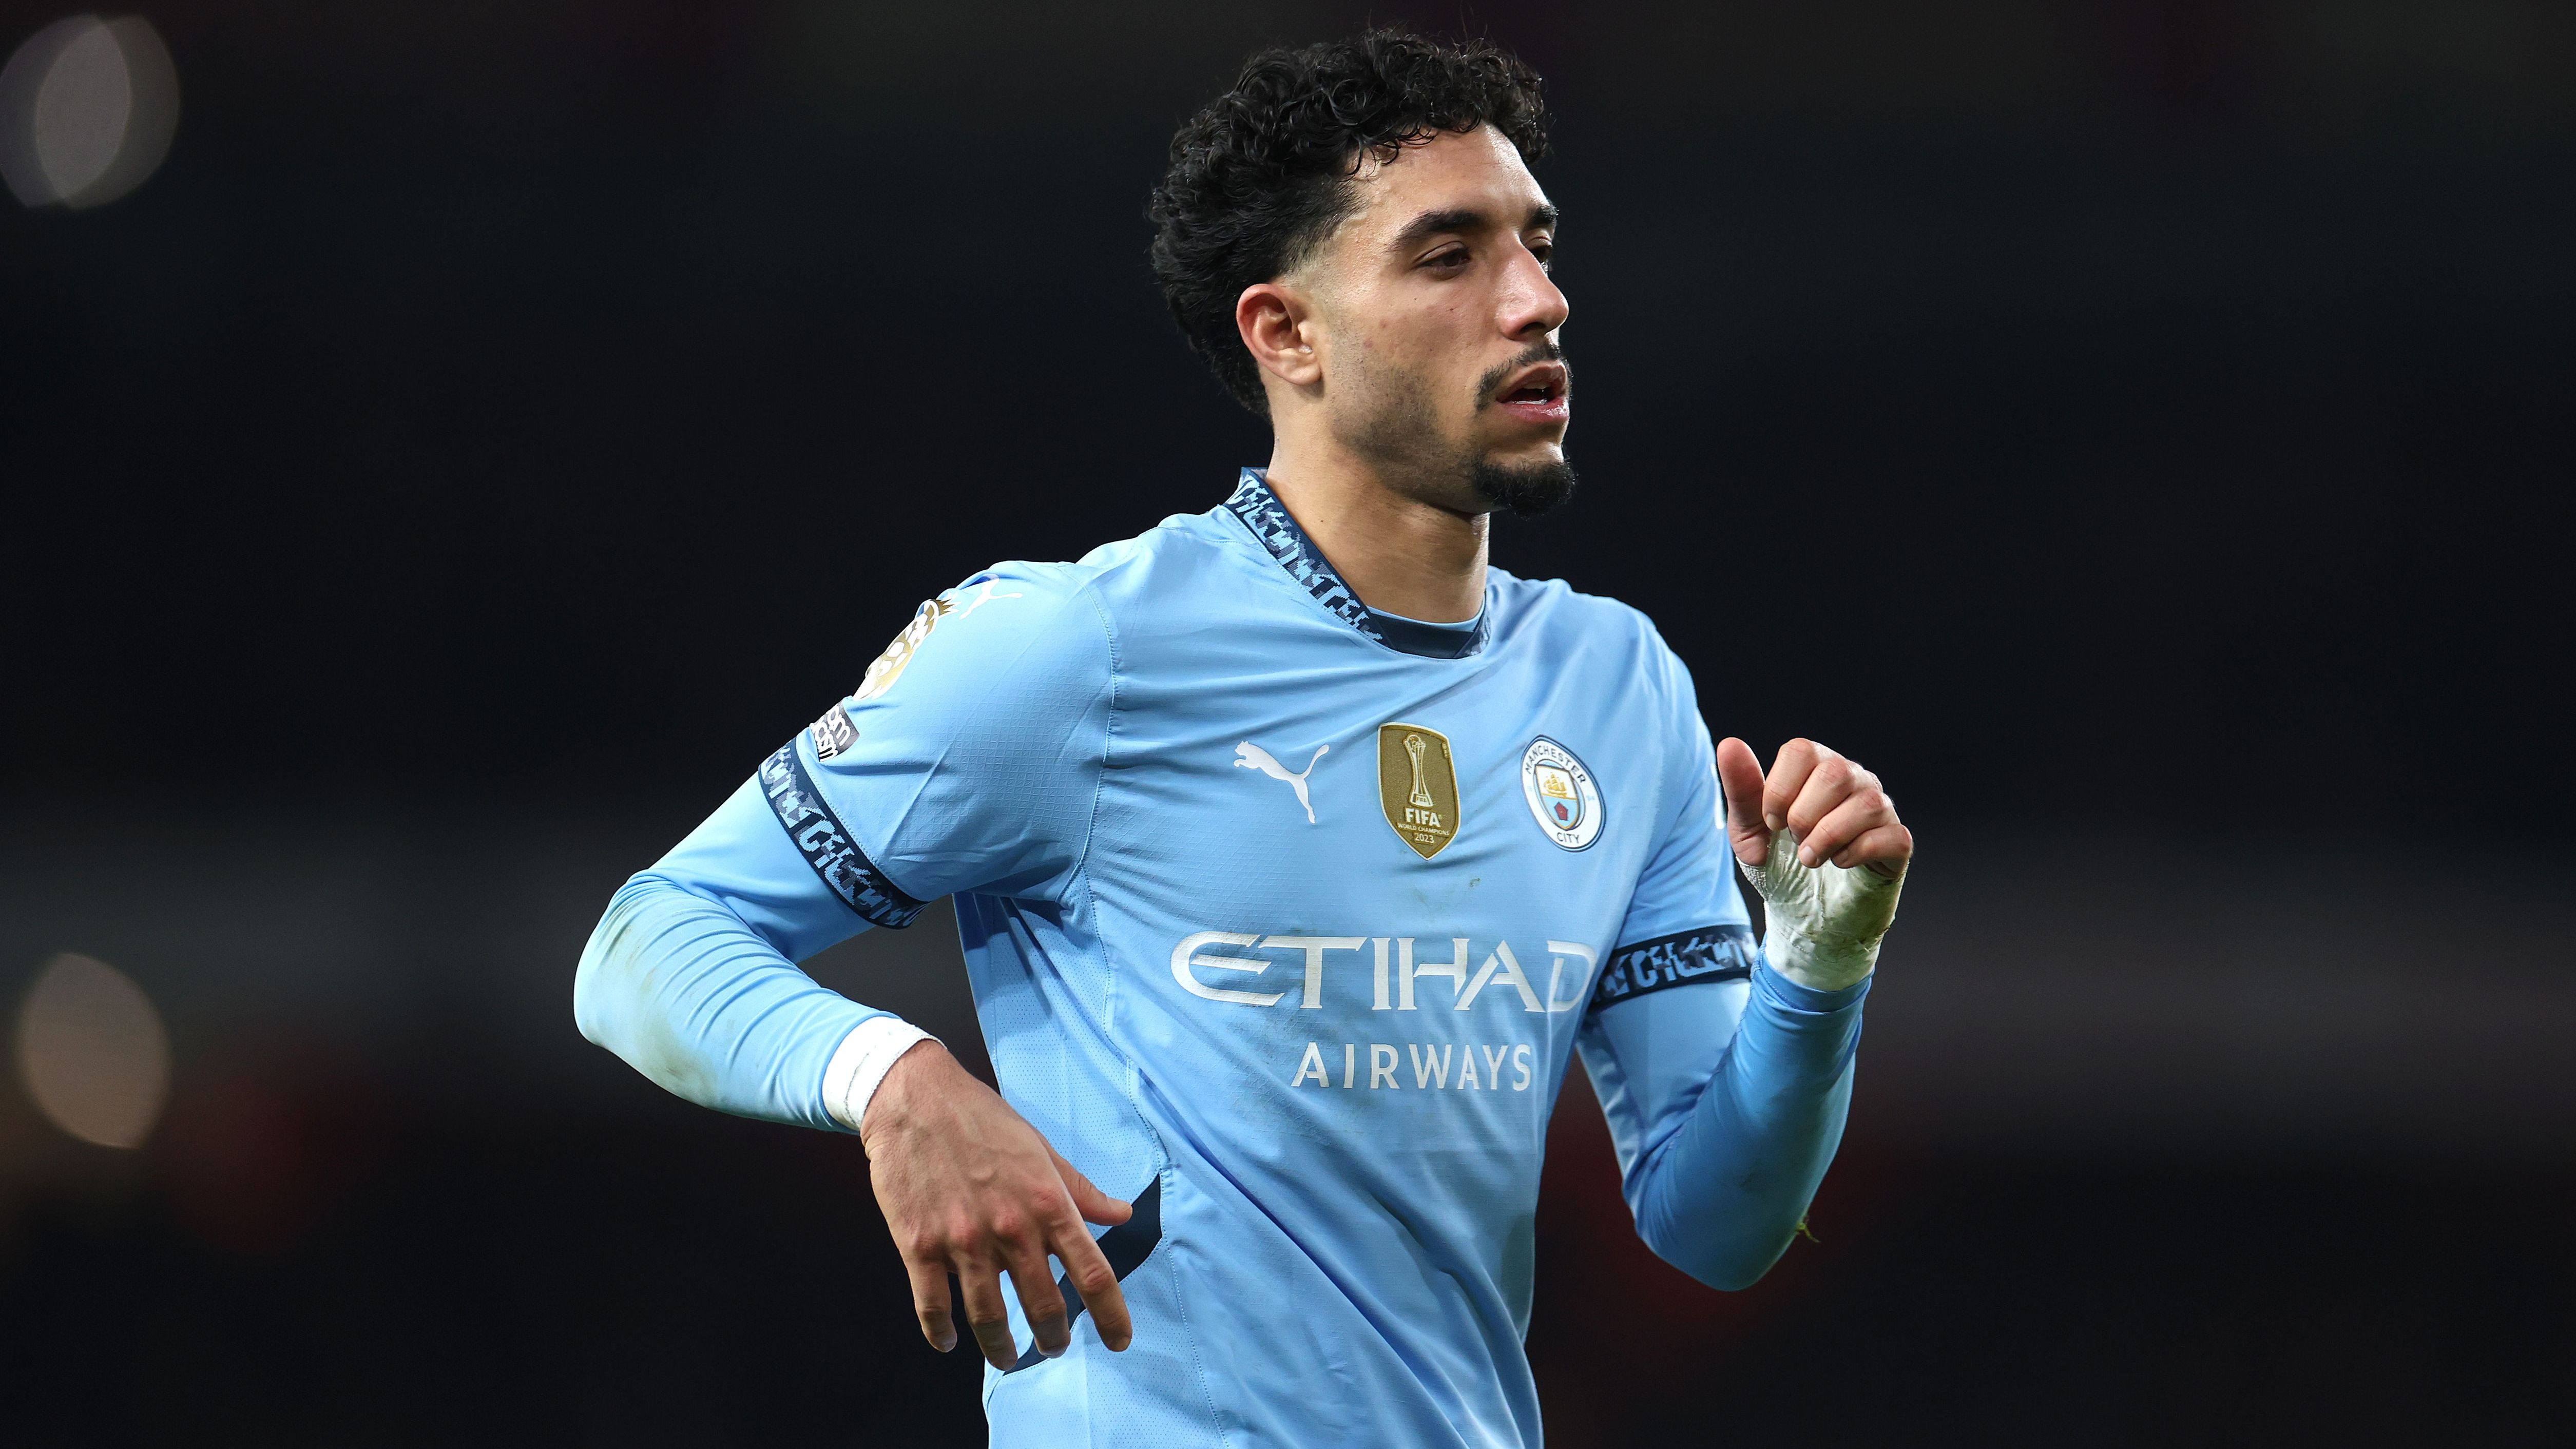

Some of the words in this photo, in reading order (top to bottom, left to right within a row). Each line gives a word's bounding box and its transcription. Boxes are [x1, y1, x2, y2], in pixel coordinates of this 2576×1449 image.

[1525, 745, 1586, 783] MANCHESTER
[1406, 808, 1440, 827] FIFA
[1414, 833, 1434, 843] 2023
[1418, 826, 1450, 836] CHAMPIONS
[1556, 832, 1580, 844] CITY
[1170, 931, 1598, 1013] ETIHAD
[1291, 1042, 1532, 1091] AIRWAYS
